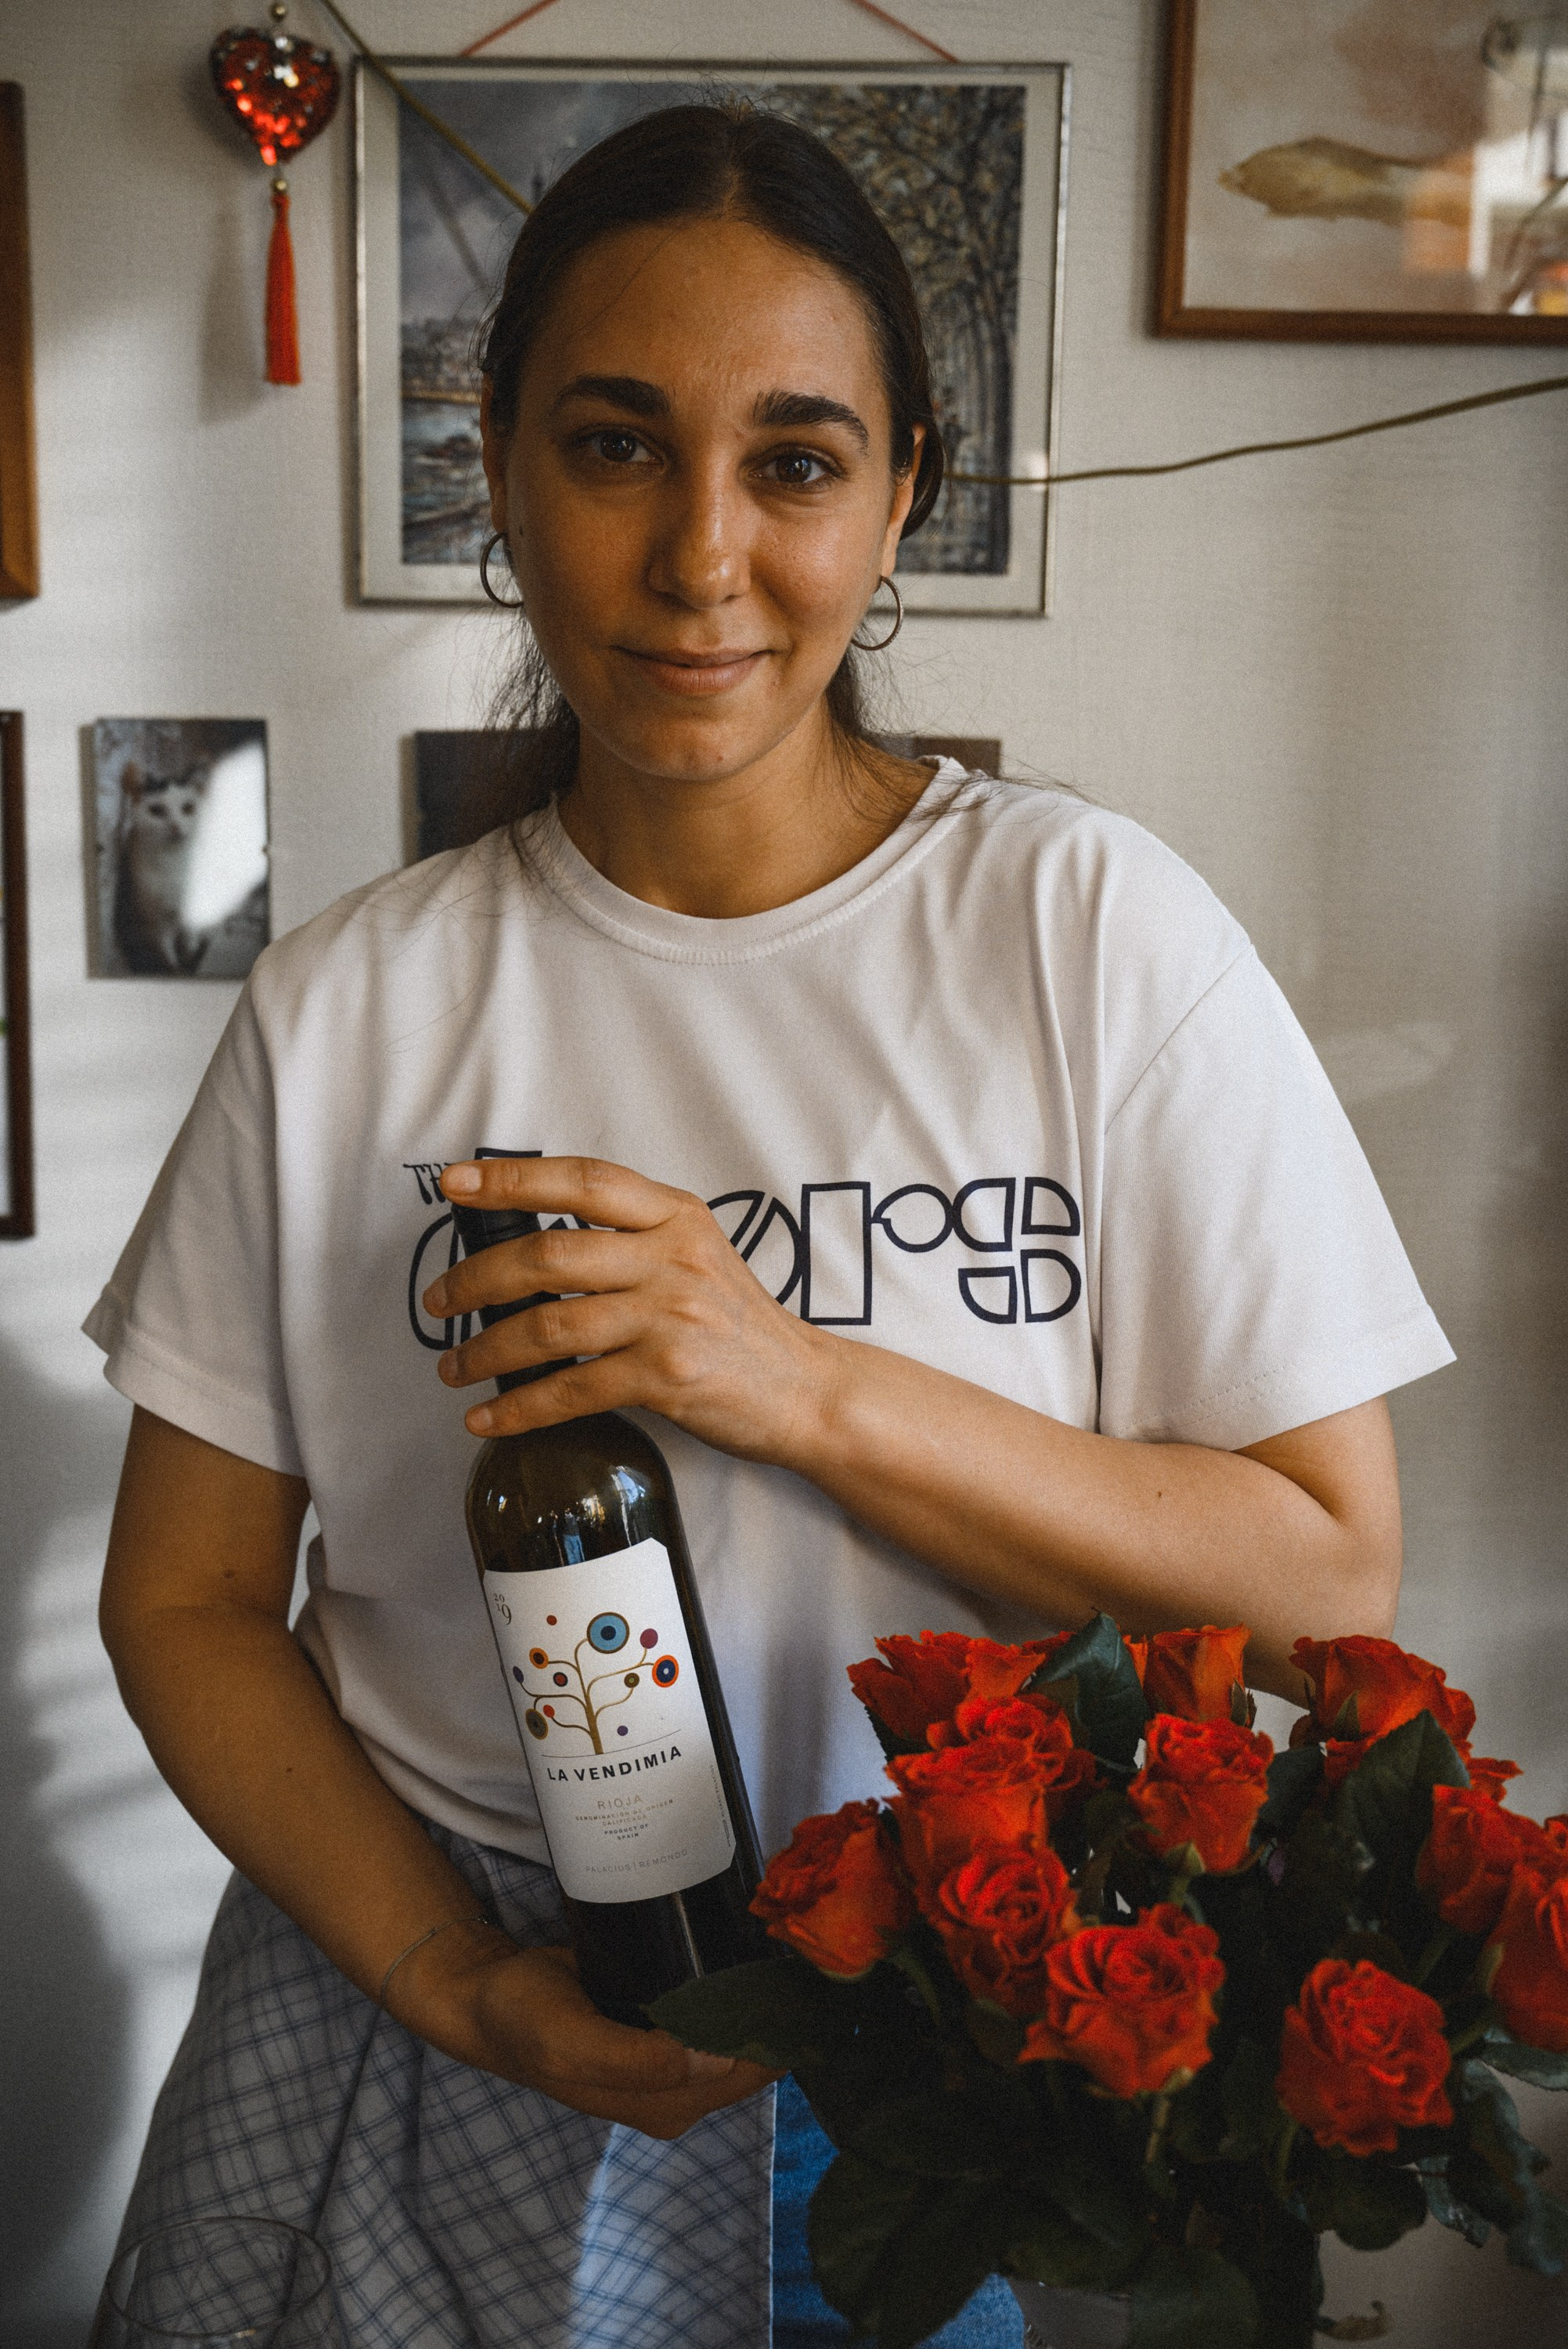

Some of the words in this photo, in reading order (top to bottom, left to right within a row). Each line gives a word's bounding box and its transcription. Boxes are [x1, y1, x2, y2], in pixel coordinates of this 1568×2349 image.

[402, 1162, 459, 1205] TH
[496, 1604, 512, 1626] 19
[547, 1767, 568, 1781] LA
[574, 1745, 682, 1781] VENDIMIA
[597, 1794, 643, 1810] RIOJA
[604, 1825, 638, 1835] PRODUCT
[617, 1832, 640, 1841] SPAIN
[585, 1863, 631, 1874] PALACIOS
[638, 1848, 688, 1868] REMONDO
